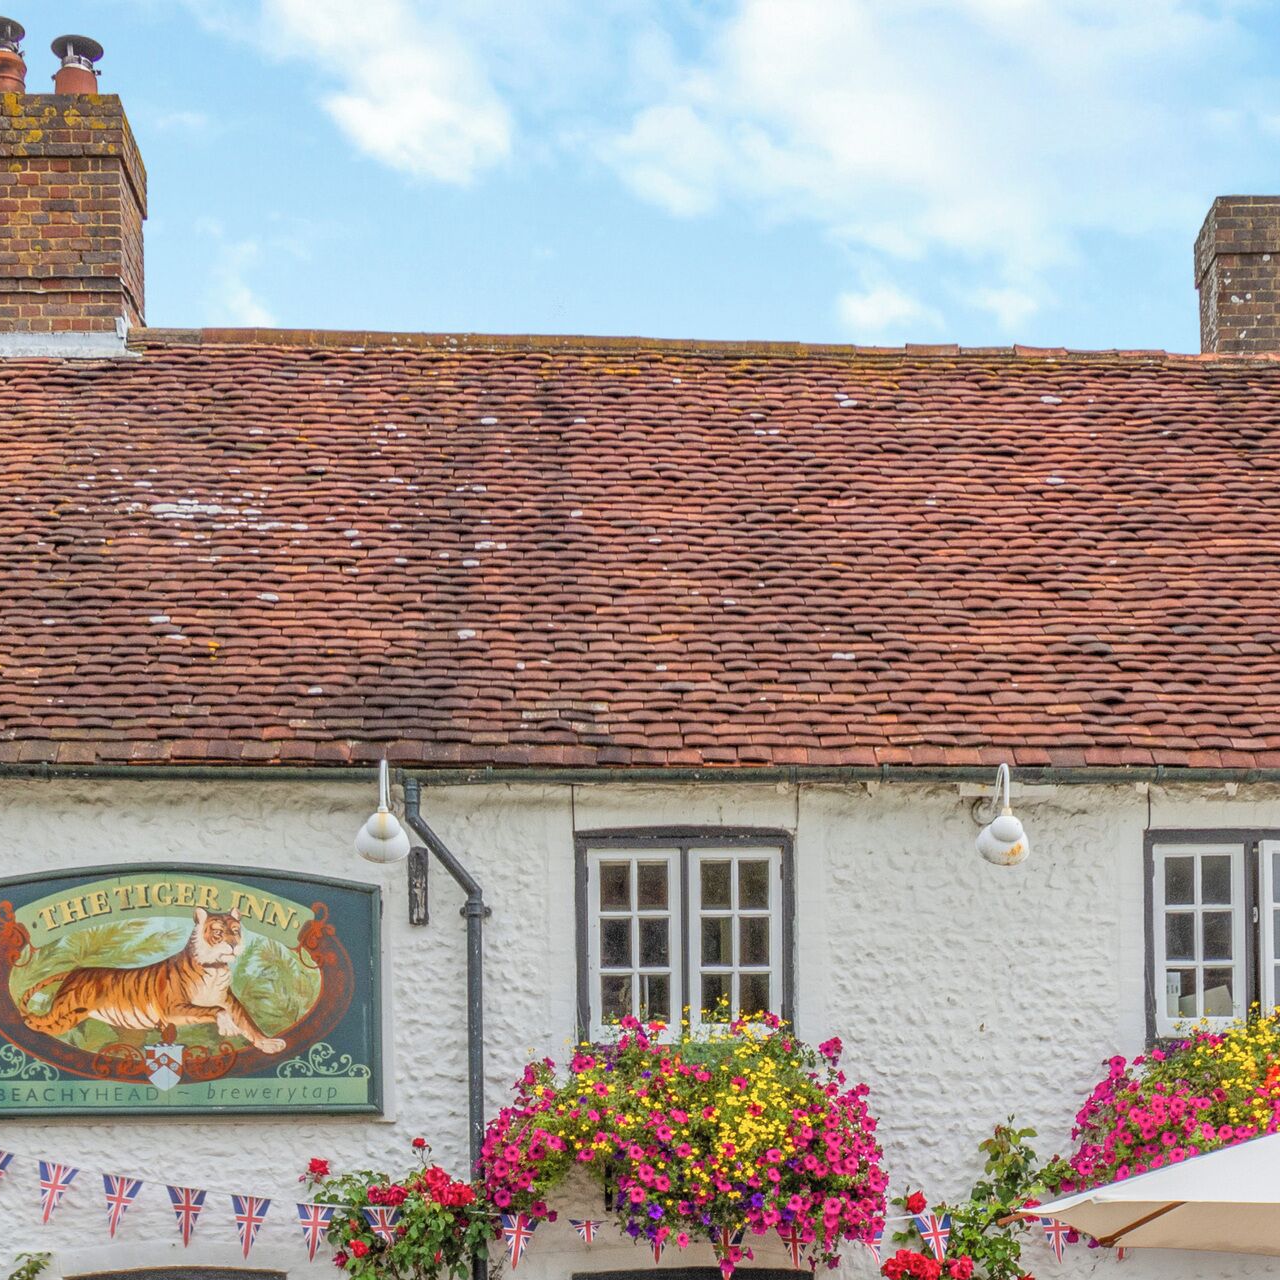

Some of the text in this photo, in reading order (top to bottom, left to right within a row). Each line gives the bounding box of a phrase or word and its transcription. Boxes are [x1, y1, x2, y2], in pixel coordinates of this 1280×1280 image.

[38, 889, 111, 931] THE
[113, 882, 222, 911] TIGER
[207, 1083, 338, 1102] brewerytap
